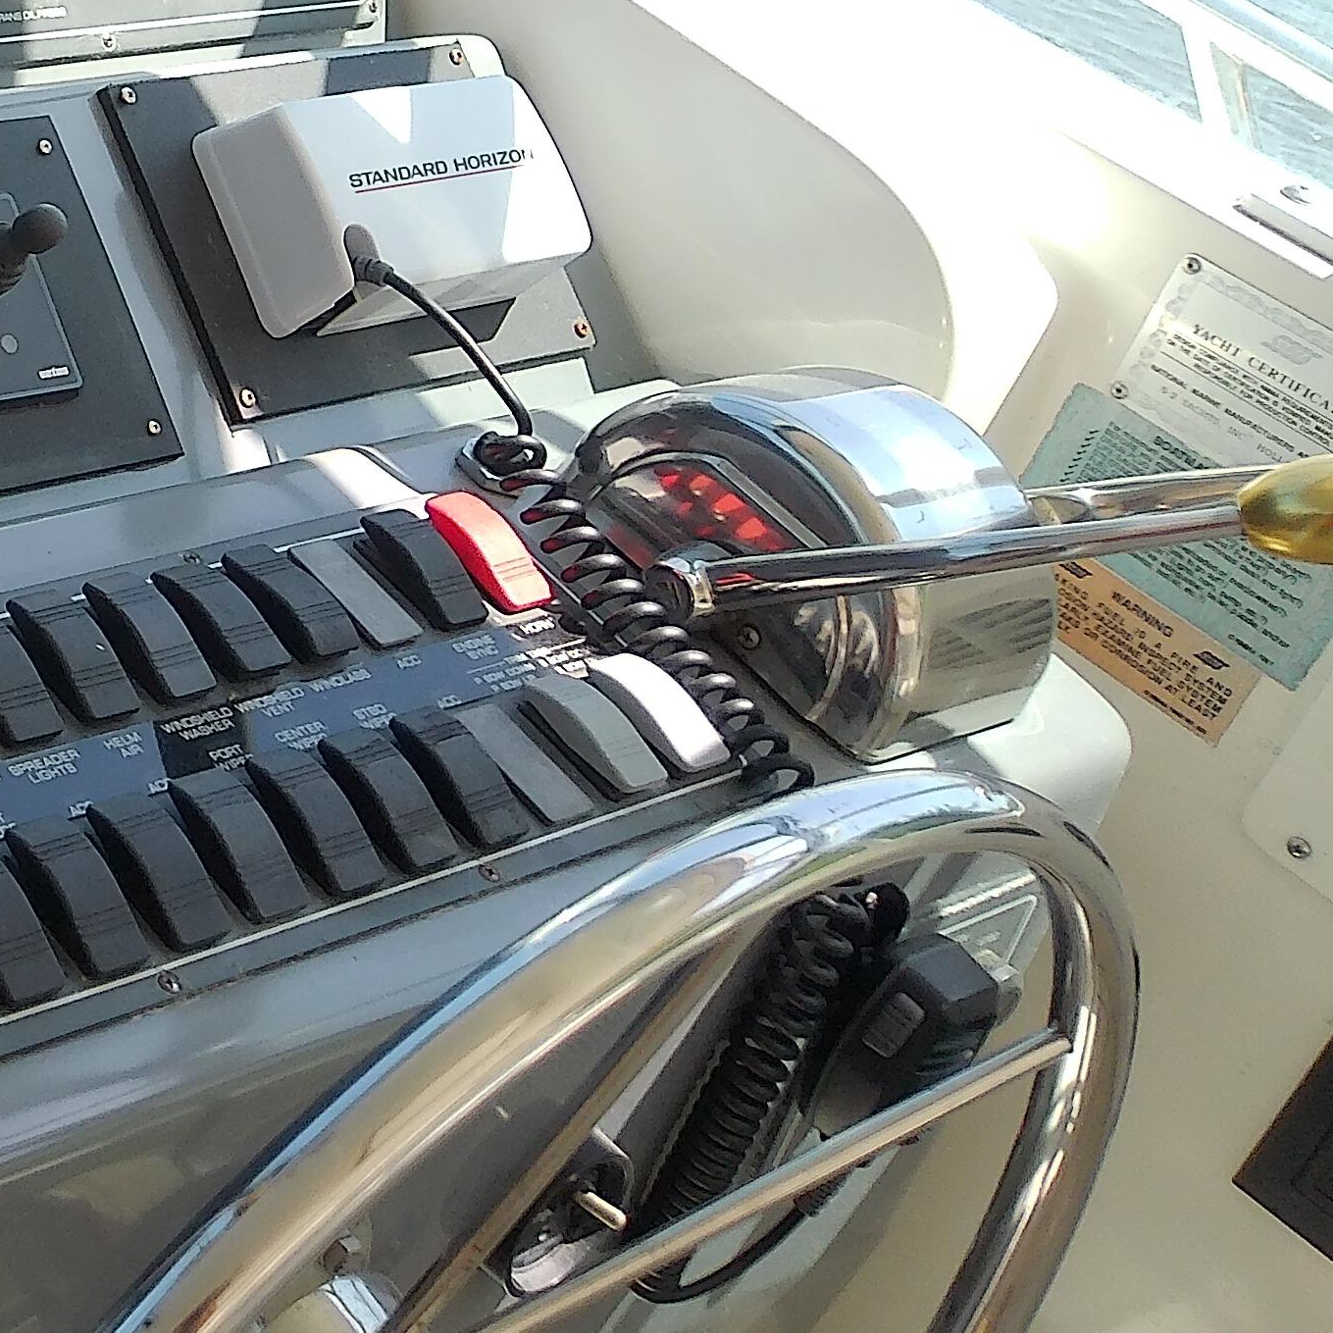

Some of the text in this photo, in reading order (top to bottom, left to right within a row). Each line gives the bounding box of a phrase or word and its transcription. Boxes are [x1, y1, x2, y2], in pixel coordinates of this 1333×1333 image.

[349, 160, 448, 188] STANDARD
[1191, 322, 1333, 416] YACHT CERTIFICA
[1110, 588, 1174, 639] WARNING
[1096, 601, 1127, 626] FUEL
[1170, 650, 1198, 674] FIRE
[1206, 675, 1233, 698] AND
[1083, 627, 1099, 641] OR
[1101, 638, 1164, 686] CORROSION
[1164, 682, 1179, 696] AT
[1180, 692, 1216, 722] LEAST
[1093, 622, 1142, 660] EXAMINE
[1145, 658, 1173, 681] FUEL
[1176, 678, 1222, 714] SYSTEM
[1137, 640, 1181, 675] INSPECT
[1184, 672, 1227, 707] SYSTEM
[233, 687, 305, 714] WINDSHIELD
[260, 701, 295, 718] VENT
[160, 706, 233, 735] WINDSHIELD
[178, 719, 235, 742] WASHER
[274, 721, 327, 742] CENTER
[103, 731, 142, 751] HELM
[120, 744, 144, 760] AIR
[208, 744, 244, 763] PORT
[7, 748, 81, 778] SPREADER
[28, 763, 78, 785] LIGHTS
